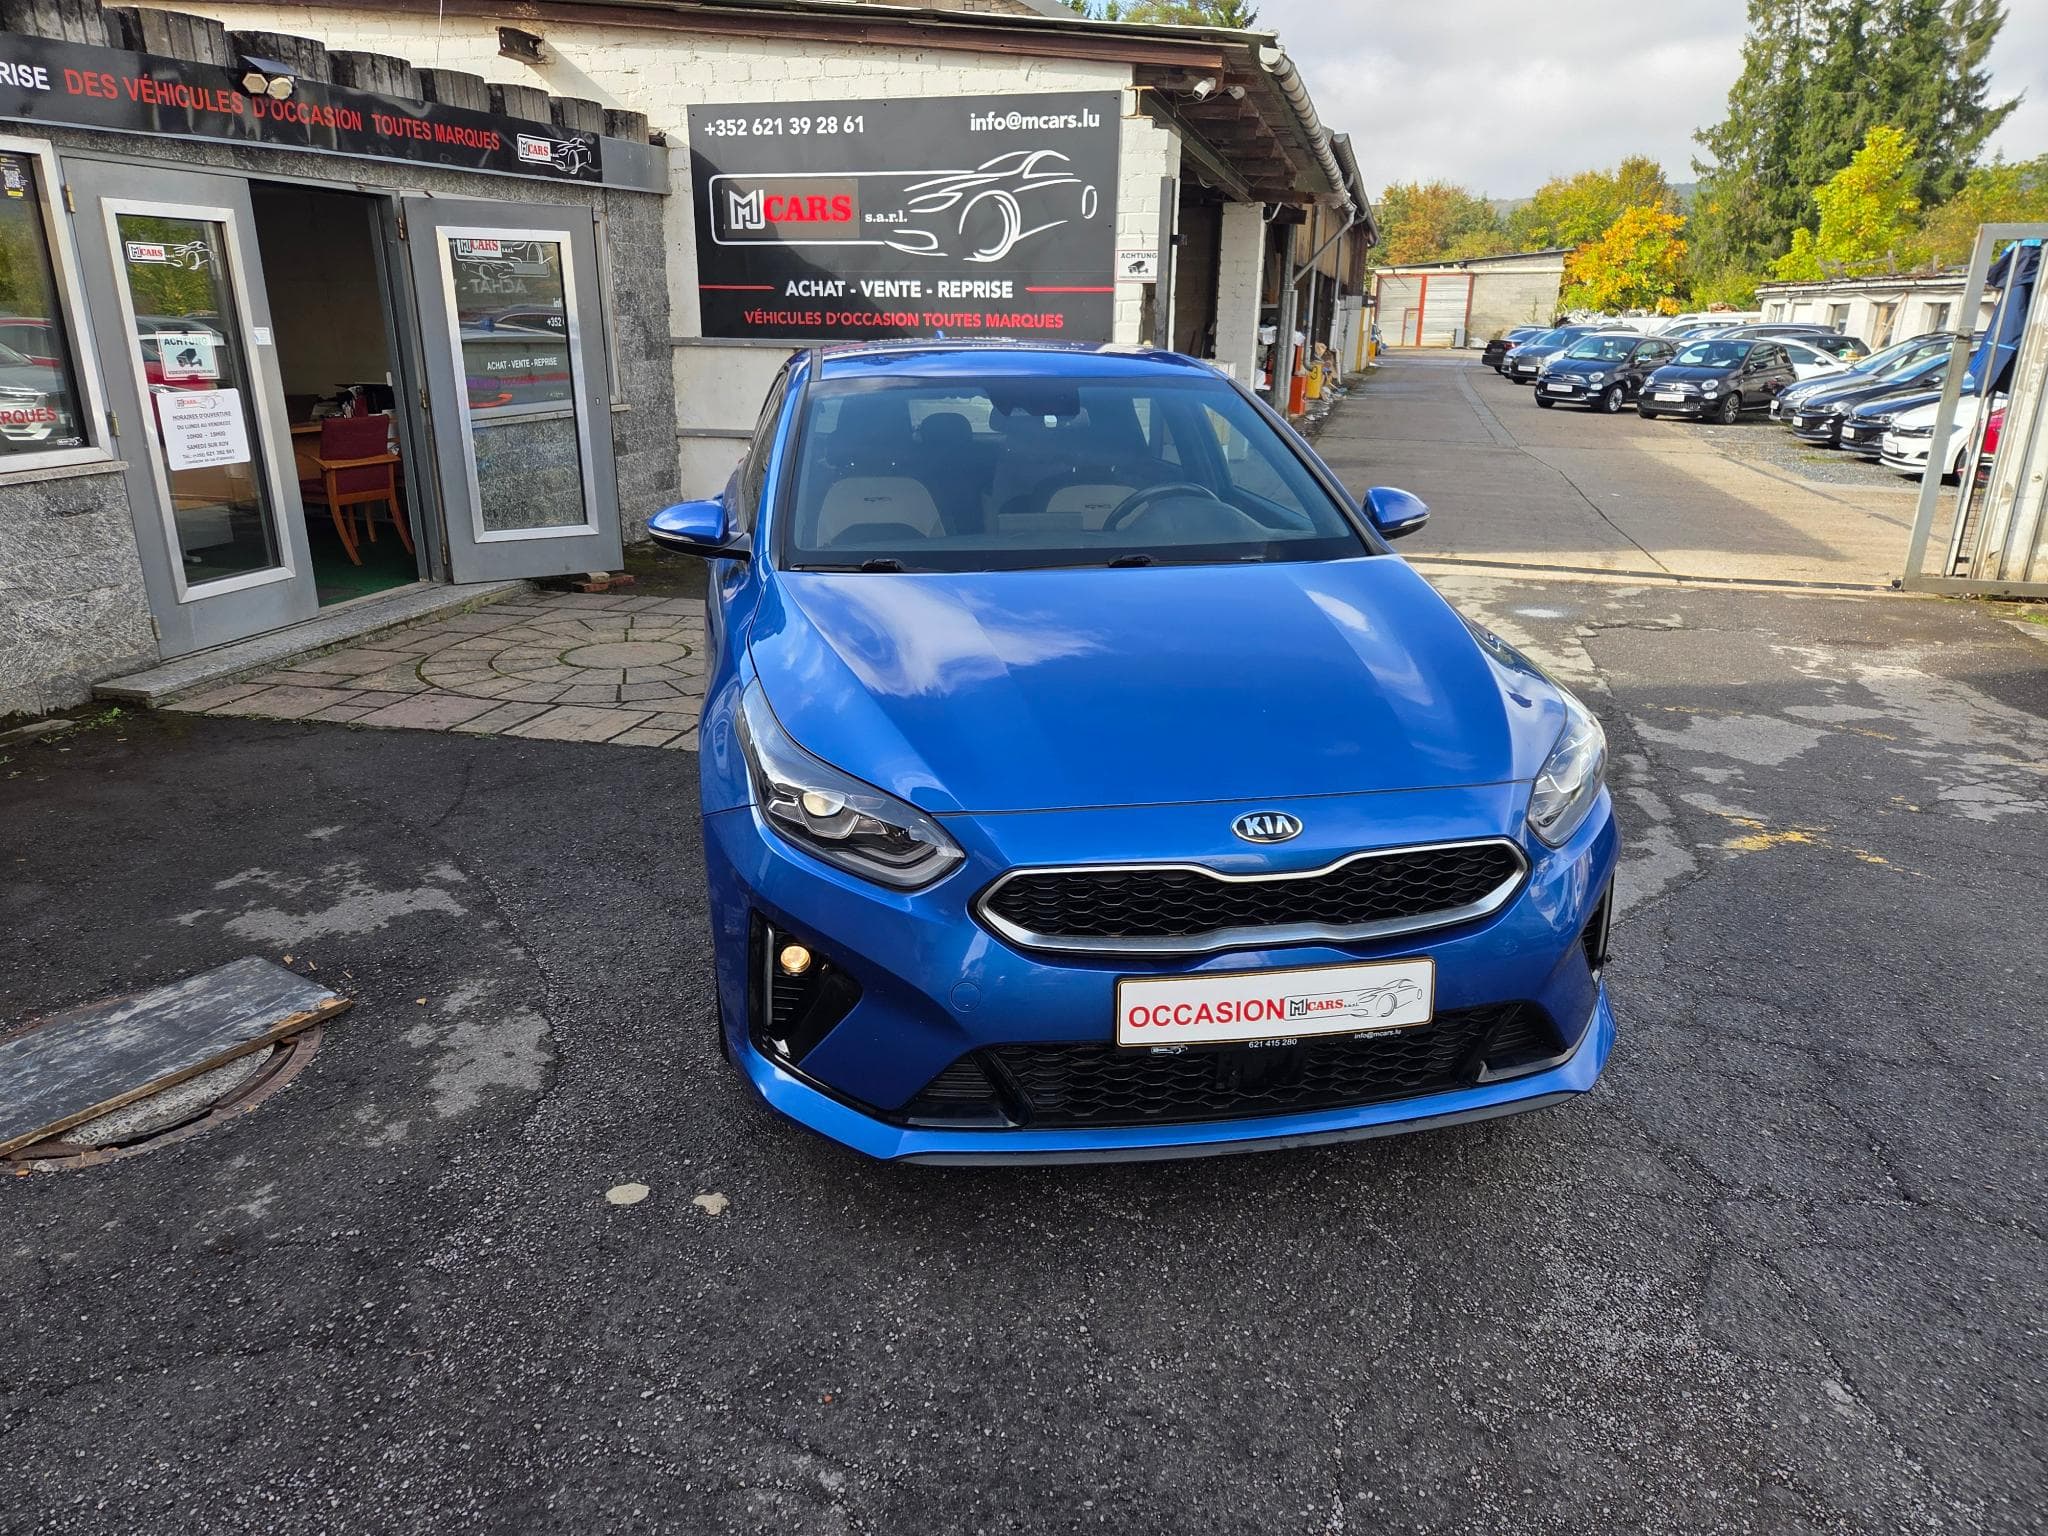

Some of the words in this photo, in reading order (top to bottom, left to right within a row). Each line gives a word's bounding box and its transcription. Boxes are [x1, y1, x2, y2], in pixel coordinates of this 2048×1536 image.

[63, 68, 118, 100] DES
[122, 72, 244, 114] VÉHICULES
[252, 96, 362, 132] D'OCCASION
[371, 113, 432, 141] TOUTES
[434, 123, 500, 150] MARQUES
[970, 108, 1100, 131] info@mcars.lu
[704, 118, 748, 136] +352
[752, 117, 783, 136] 621
[789, 116, 811, 135] 39
[816, 115, 838, 134] 28
[843, 115, 864, 134] 61
[864, 209, 908, 223] s.a.r.l.
[785, 280, 846, 297] ACHAT
[860, 280, 922, 298] VENTE
[938, 280, 1013, 299] REPRISE
[744, 308, 822, 325] VÉHICULES
[826, 312, 919, 328] D'OCCASION
[923, 313, 981, 328] TOUTES
[985, 313, 1064, 329] MARQUES
[487, 360, 507, 370] ACHAT
[511, 358, 531, 369] VENTE
[534, 357, 558, 367] REPRISE
[1243, 815, 1294, 836] KIA
[1128, 998, 1285, 1028] OCCASION
[1249, 1041, 1263, 1049] 621
[1265, 1040, 1280, 1048] 415
[1282, 1038, 1297, 1046] 280
